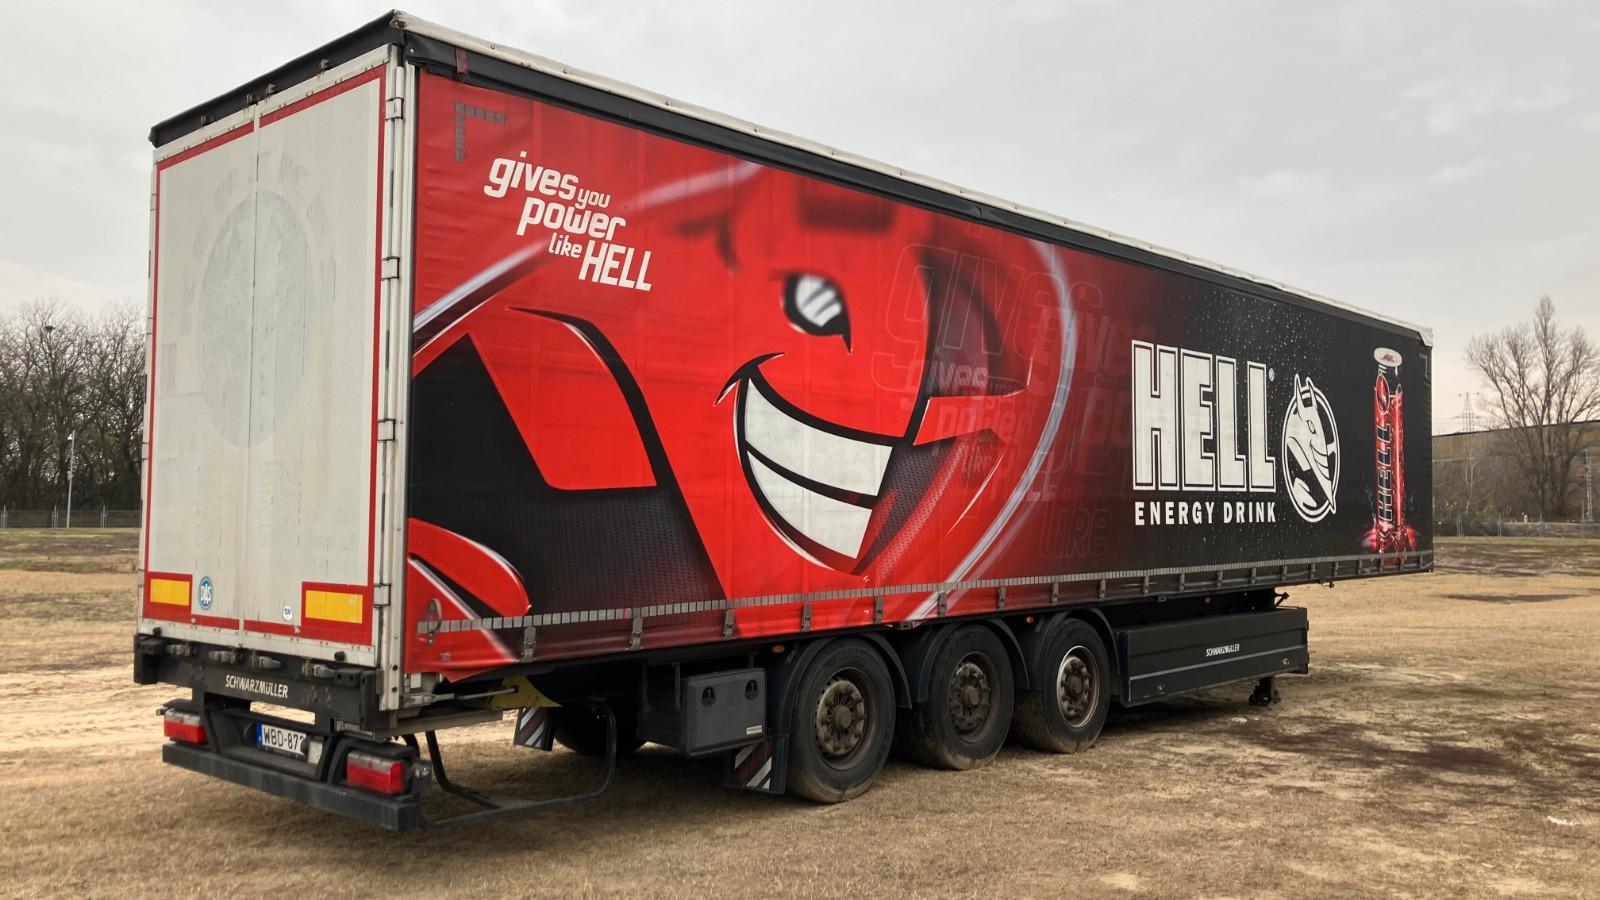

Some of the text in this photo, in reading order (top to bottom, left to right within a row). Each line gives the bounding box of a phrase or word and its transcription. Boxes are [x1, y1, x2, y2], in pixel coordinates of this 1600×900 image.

[484, 151, 611, 210] gives you
[516, 196, 626, 241] power
[549, 232, 652, 291] like HELL
[1376, 422, 1394, 525] HELL
[1135, 501, 1277, 526] ENERGY DRINK
[225, 674, 289, 700] SCHWARZMÜLLER
